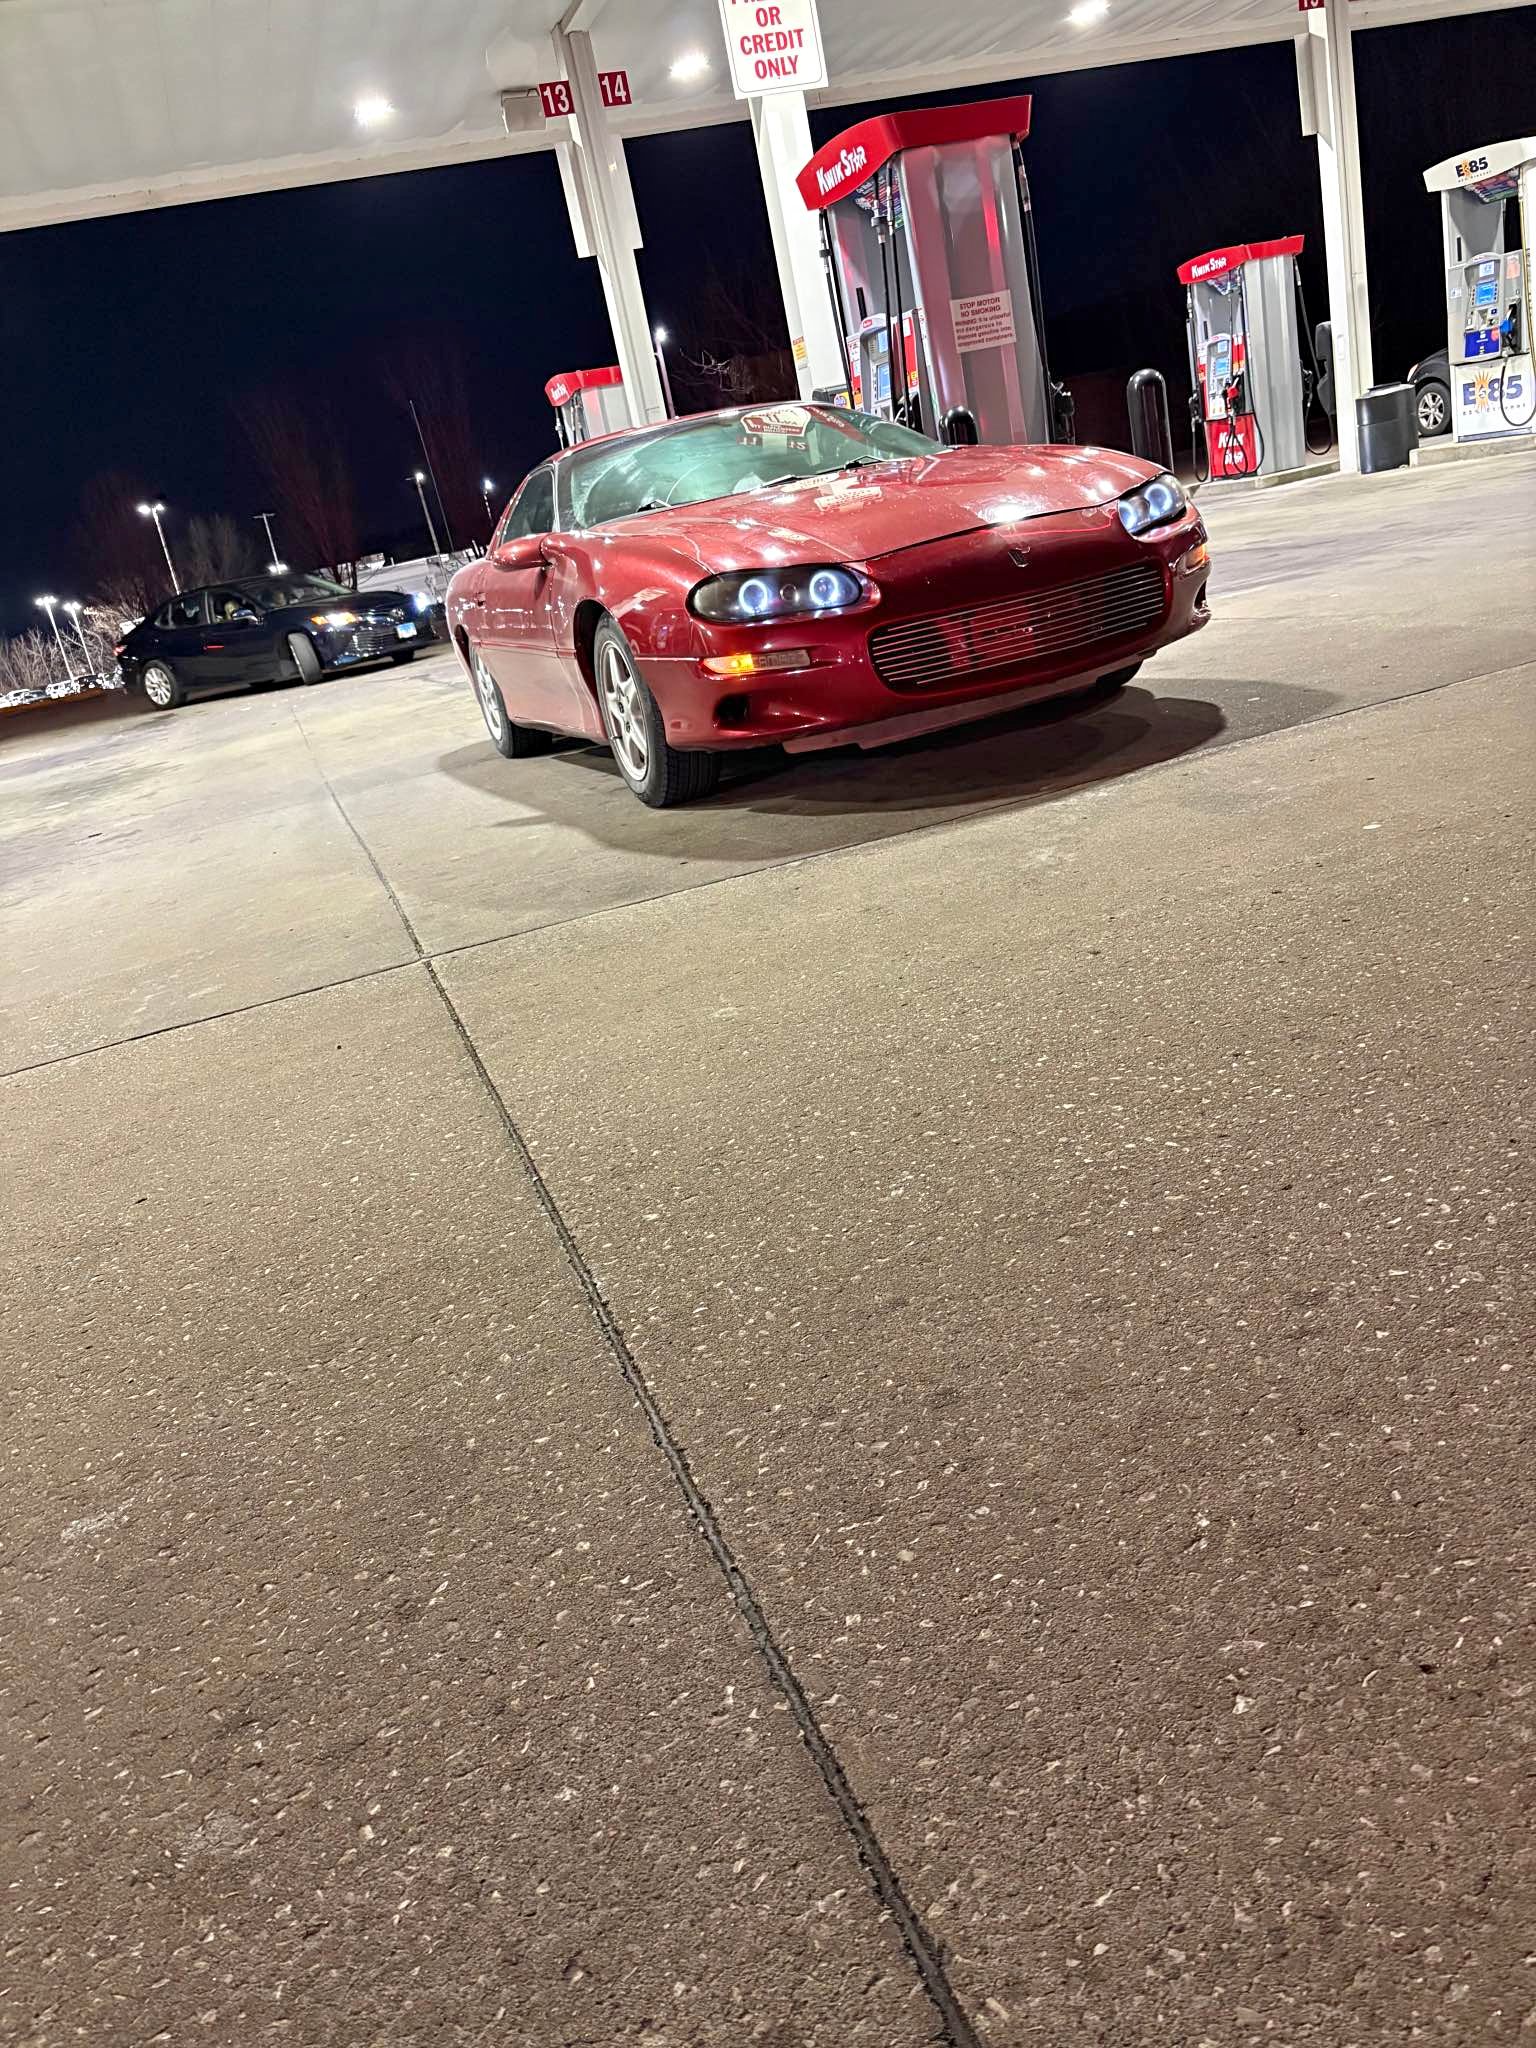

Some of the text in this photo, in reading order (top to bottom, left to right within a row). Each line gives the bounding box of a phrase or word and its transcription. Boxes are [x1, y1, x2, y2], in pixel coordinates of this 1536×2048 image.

[755, 6, 782, 27] OR
[739, 28, 804, 55] CREDIT
[754, 55, 799, 79] ONLY
[543, 84, 570, 114] 13
[601, 74, 627, 104] 14
[971, 305, 1001, 316] SMOKING
[976, 297, 1000, 306] MOTOR
